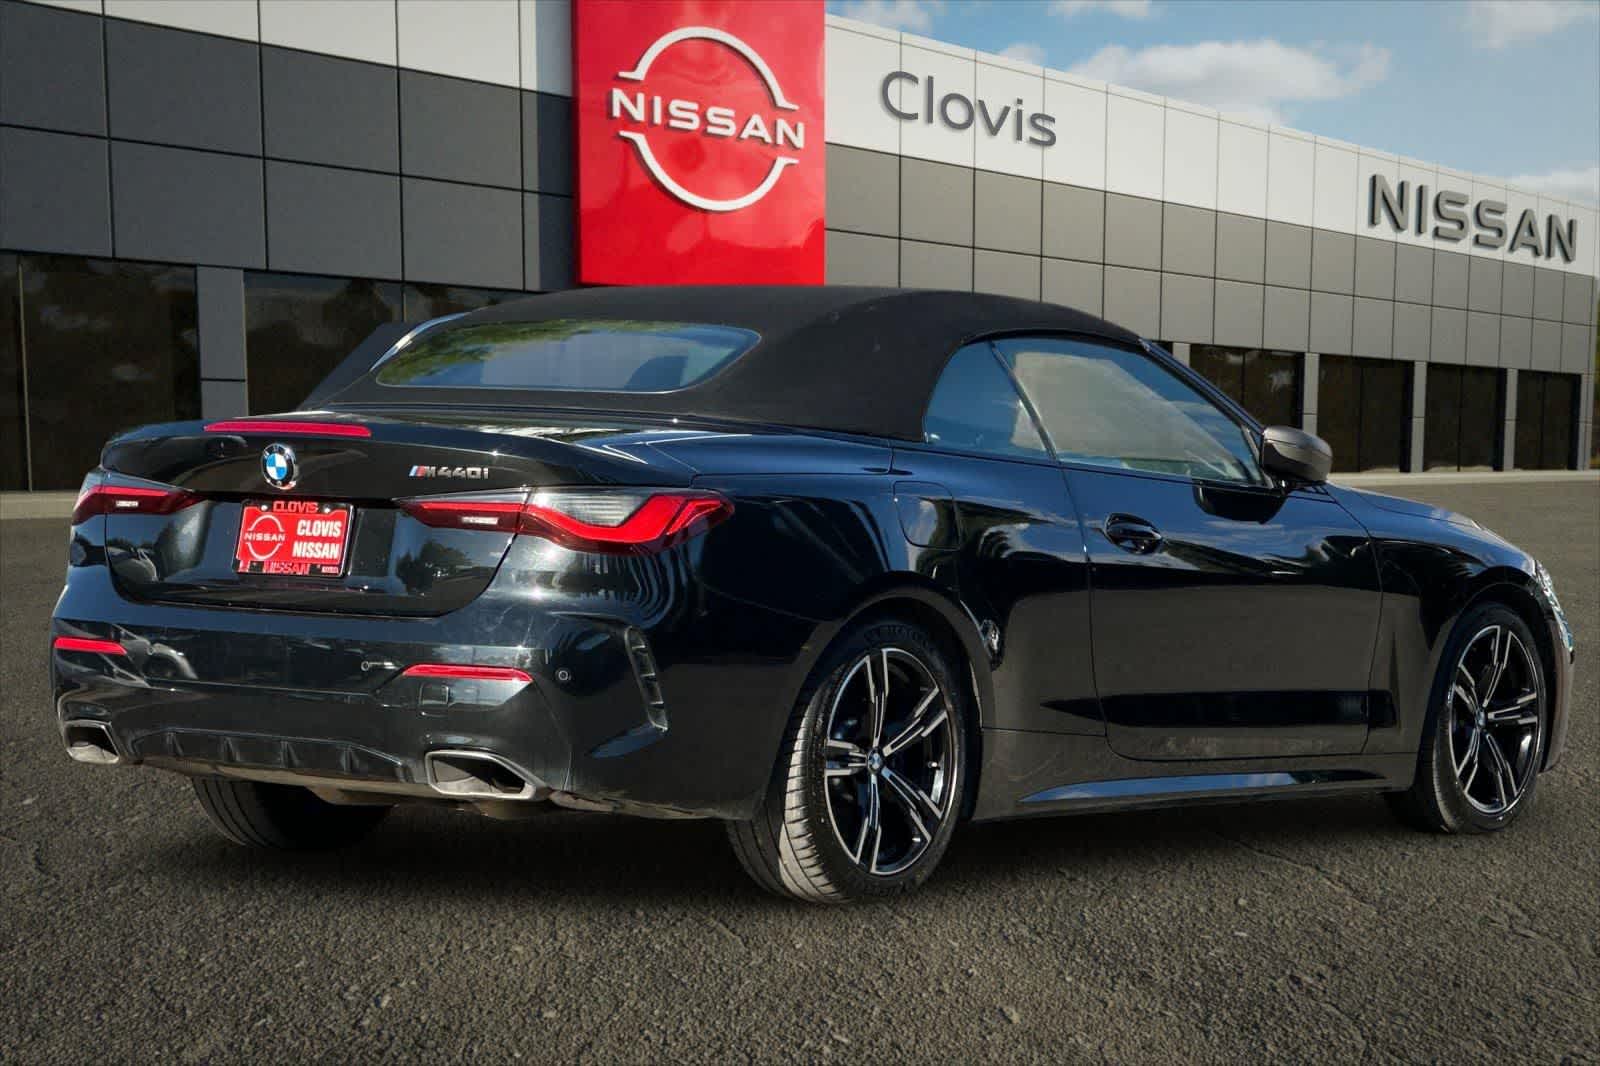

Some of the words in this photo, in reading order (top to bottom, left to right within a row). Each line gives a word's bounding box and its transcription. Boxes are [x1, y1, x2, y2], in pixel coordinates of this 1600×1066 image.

[612, 88, 804, 149] NISSAN
[881, 71, 1057, 147] Clovis
[1368, 174, 1578, 263] NISSAN
[273, 500, 319, 513] CLOVIS
[244, 532, 286, 542] NISSAN
[296, 519, 342, 538] CLOVIS
[292, 541, 340, 560] NISSAN
[263, 560, 310, 575] NISSAN
